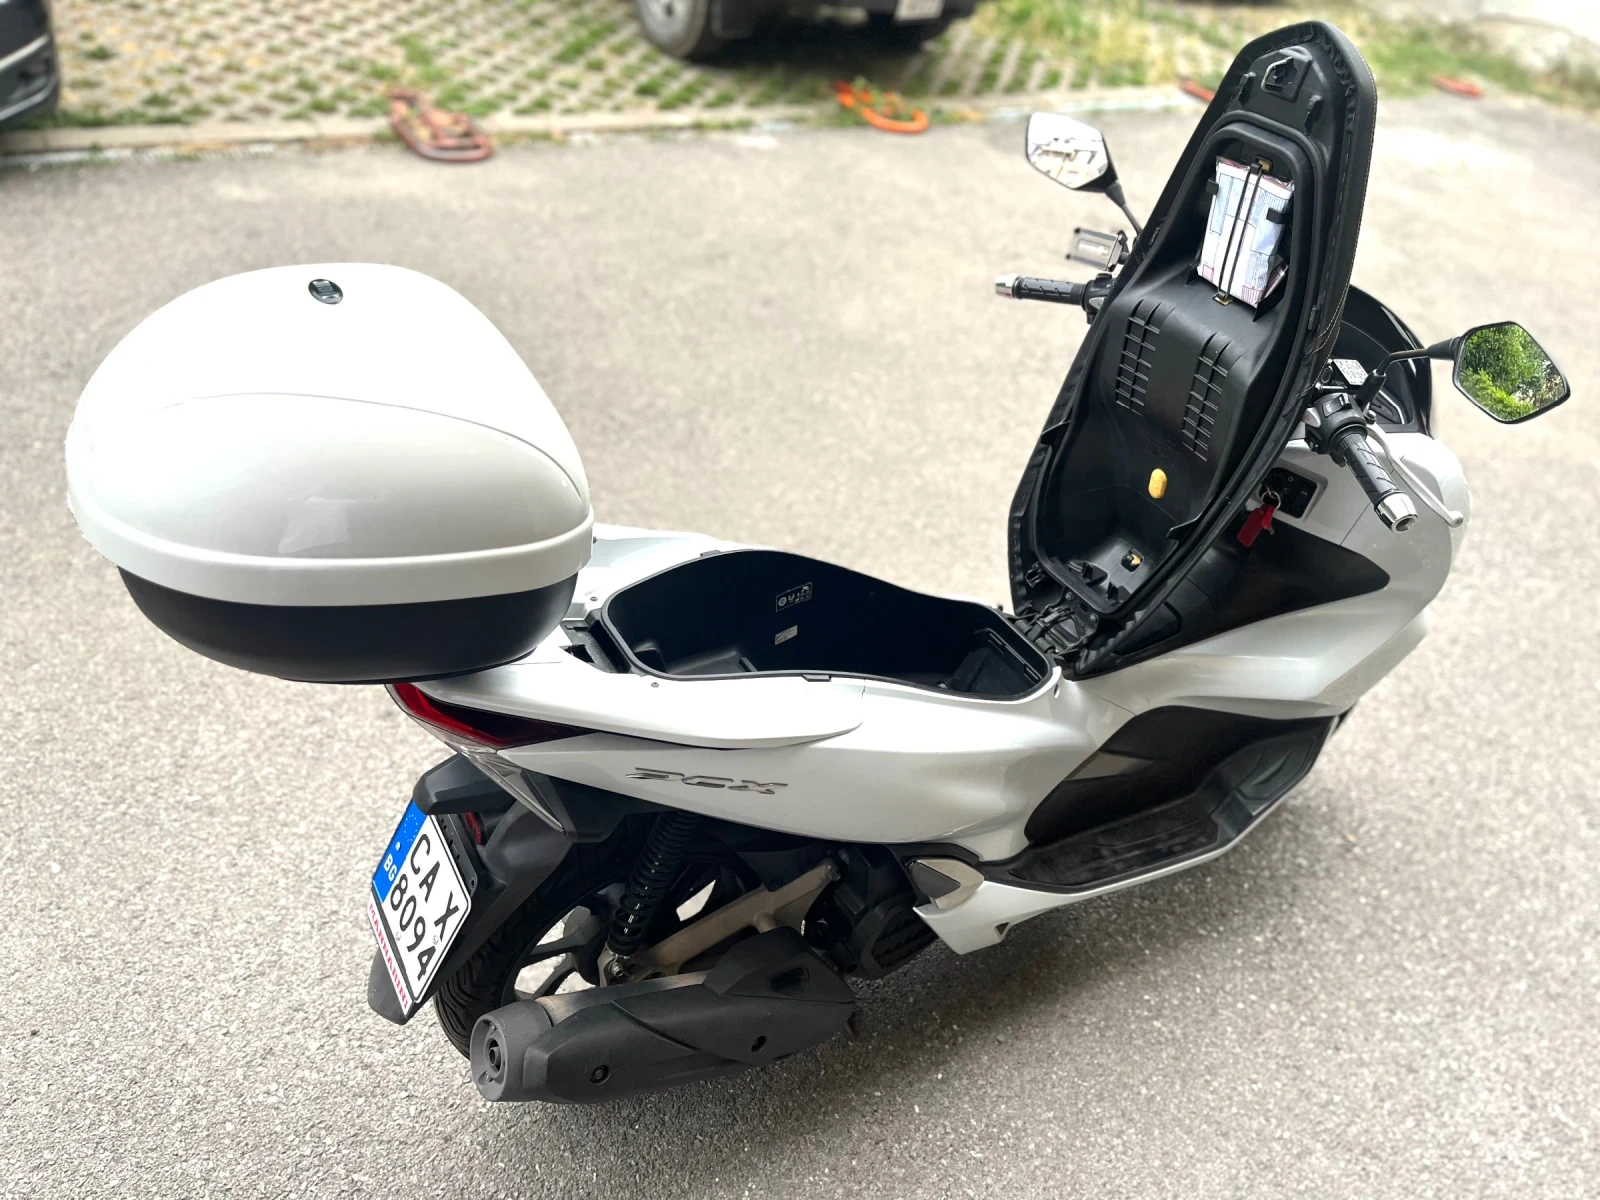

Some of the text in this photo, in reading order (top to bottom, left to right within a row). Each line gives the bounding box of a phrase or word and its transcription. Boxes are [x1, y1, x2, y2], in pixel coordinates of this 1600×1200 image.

[625, 767, 788, 795] PCX
[383, 853, 398, 882] BG
[390, 873, 437, 981] 8094
